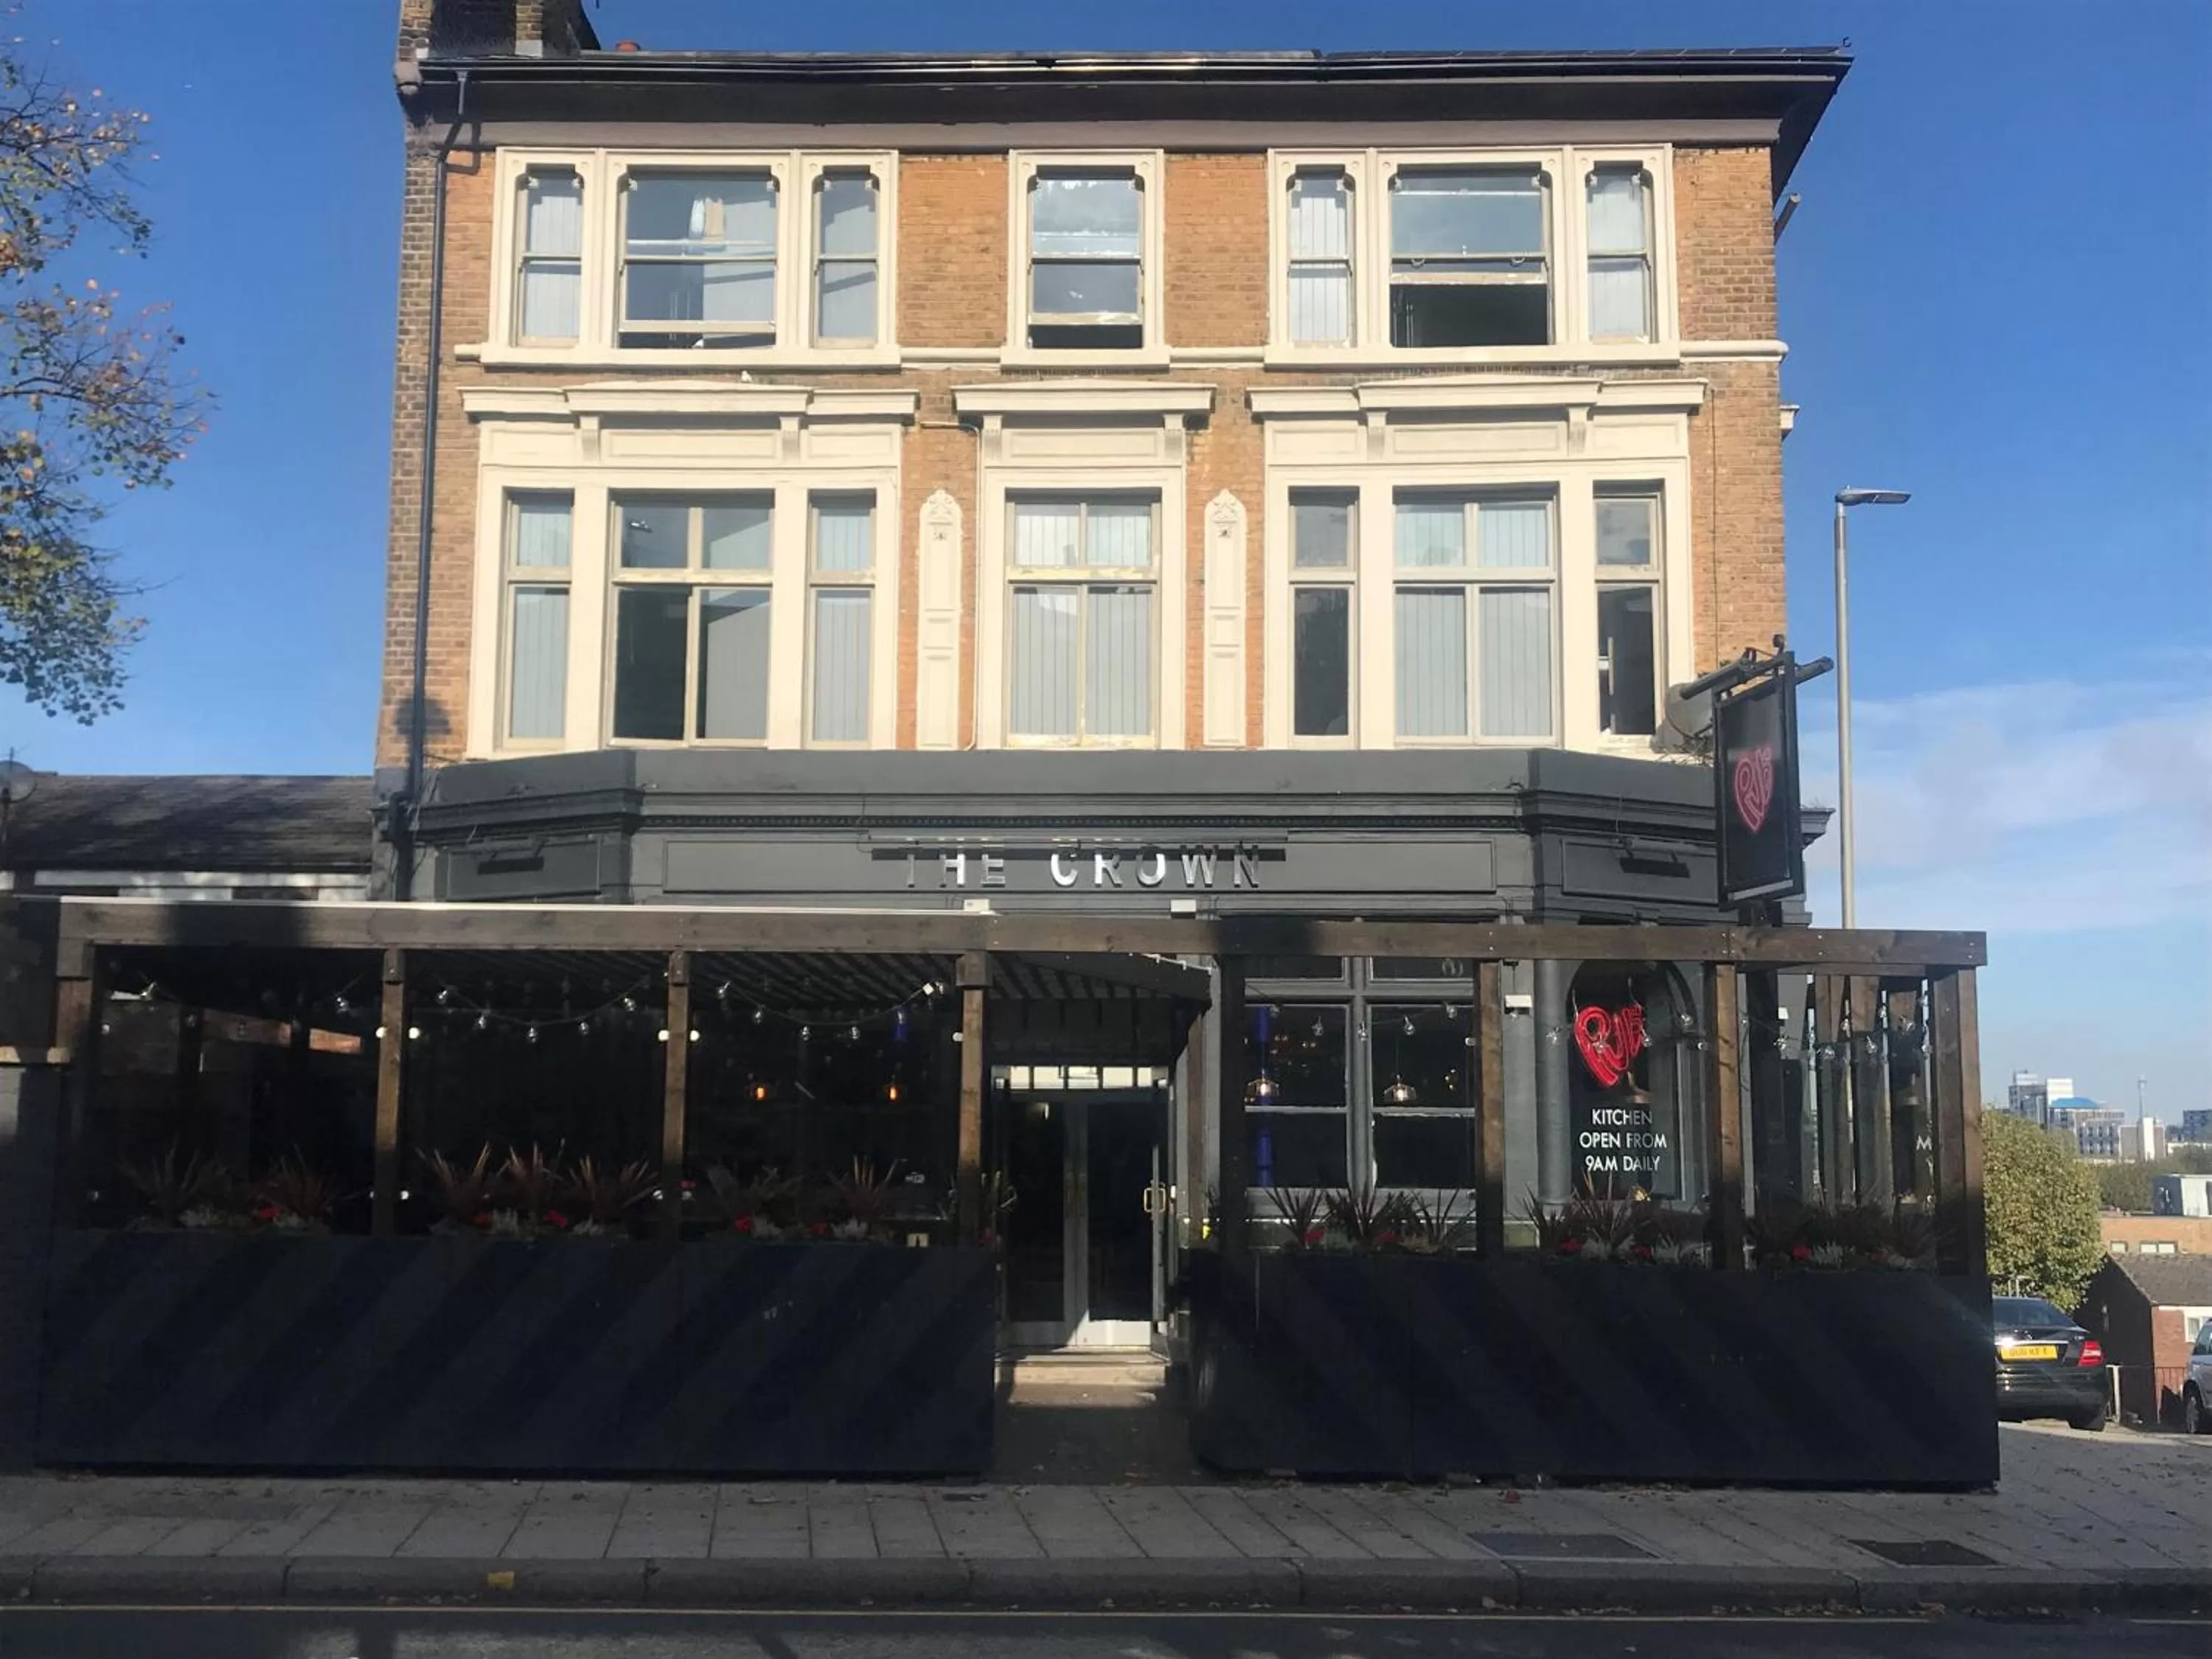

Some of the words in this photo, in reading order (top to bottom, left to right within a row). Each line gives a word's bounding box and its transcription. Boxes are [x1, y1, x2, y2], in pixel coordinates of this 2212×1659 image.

[899, 846, 1006, 887] THE
[1051, 845, 1259, 887] CROWN
[1592, 1109, 1652, 1125] KITCHEN
[1579, 1132, 1621, 1148] OPEN
[1627, 1133, 1667, 1148] FROM
[1585, 1155, 1618, 1172] 9AM
[1623, 1155, 1660, 1172] DAILY
